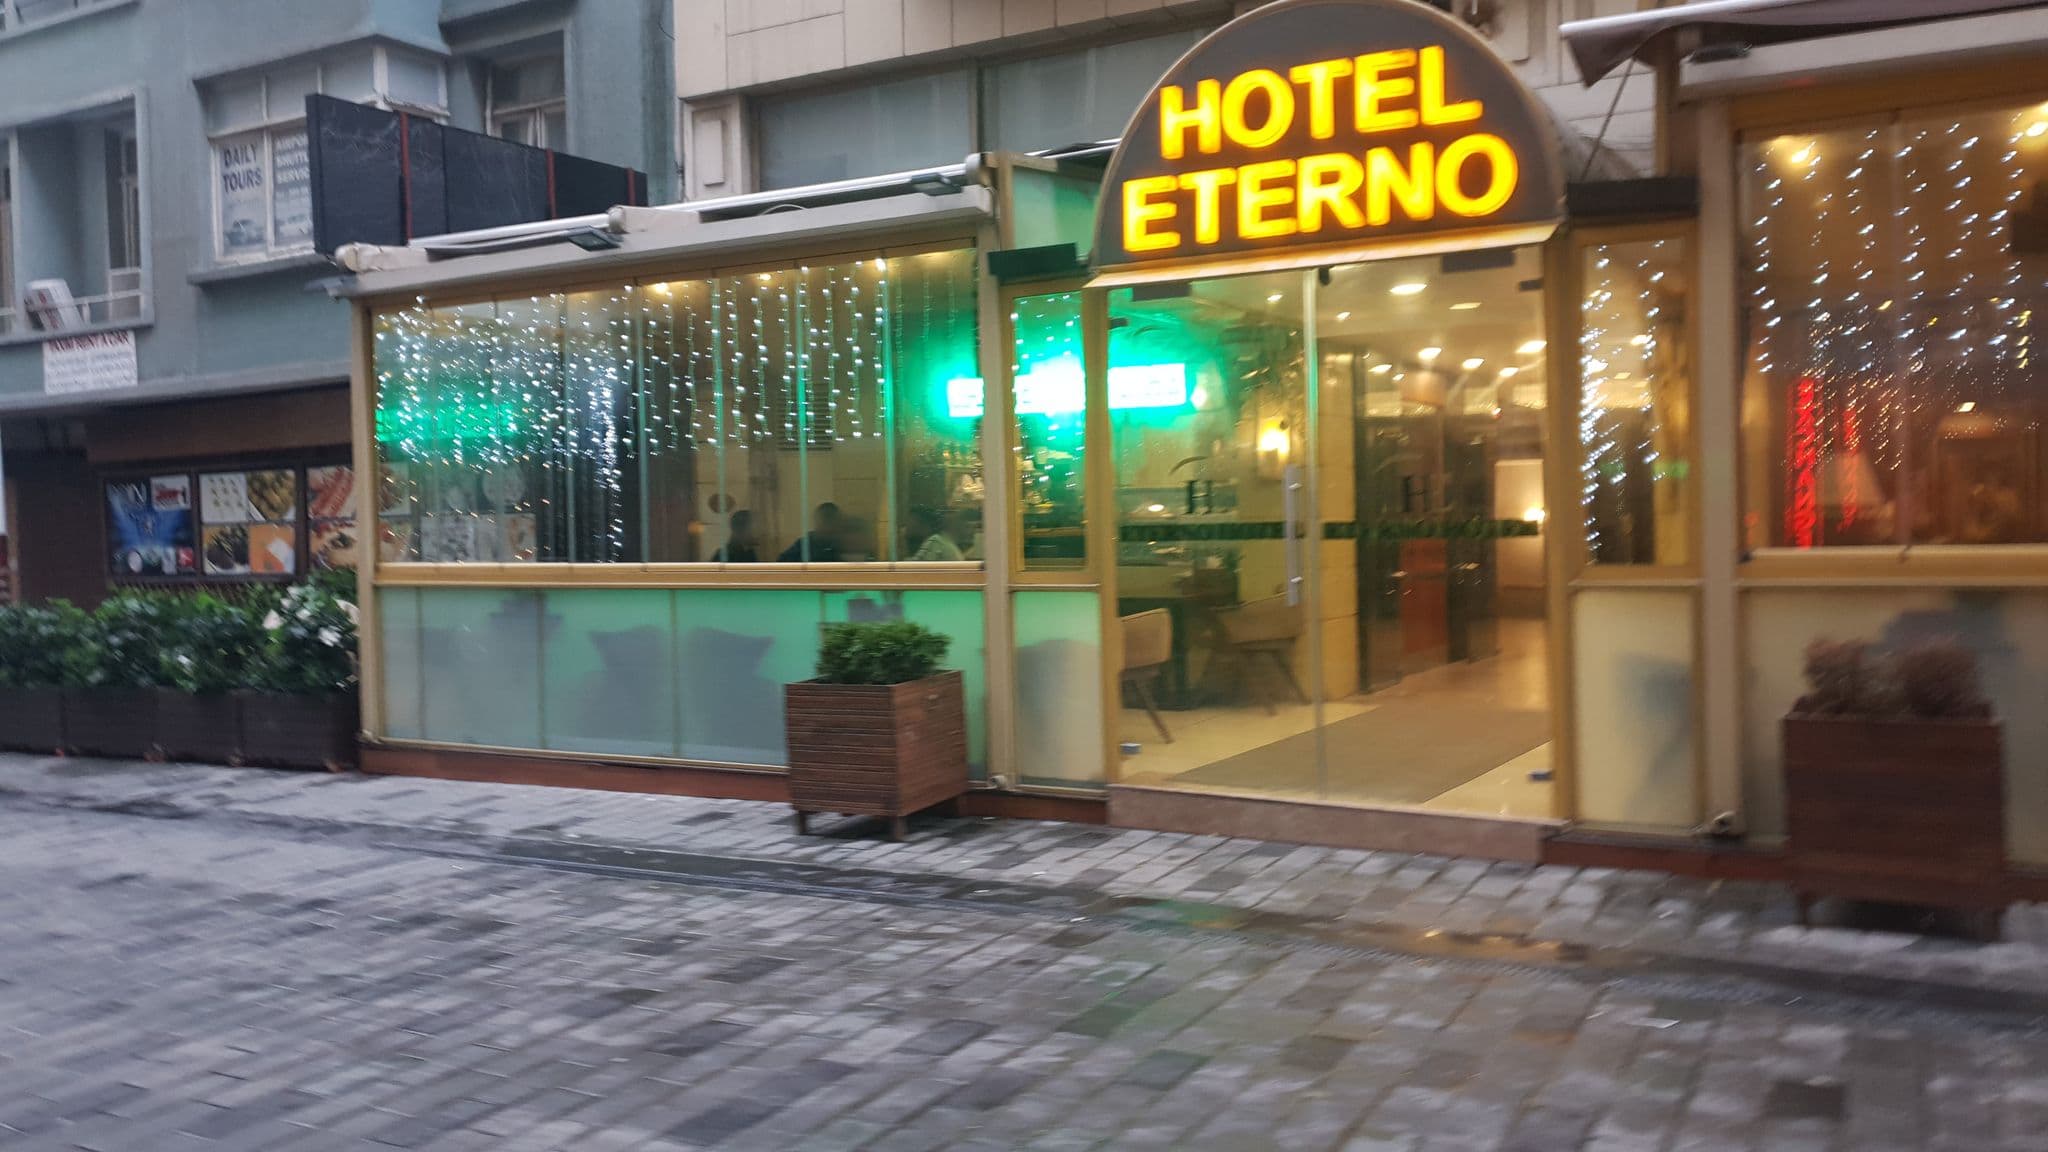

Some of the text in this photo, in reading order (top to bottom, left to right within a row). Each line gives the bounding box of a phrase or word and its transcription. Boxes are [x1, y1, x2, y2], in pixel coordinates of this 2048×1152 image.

[1159, 45, 1484, 160] HOTEL
[222, 167, 263, 194] TOURS
[223, 143, 258, 168] DAILY
[1121, 132, 1519, 252] ETERNO
